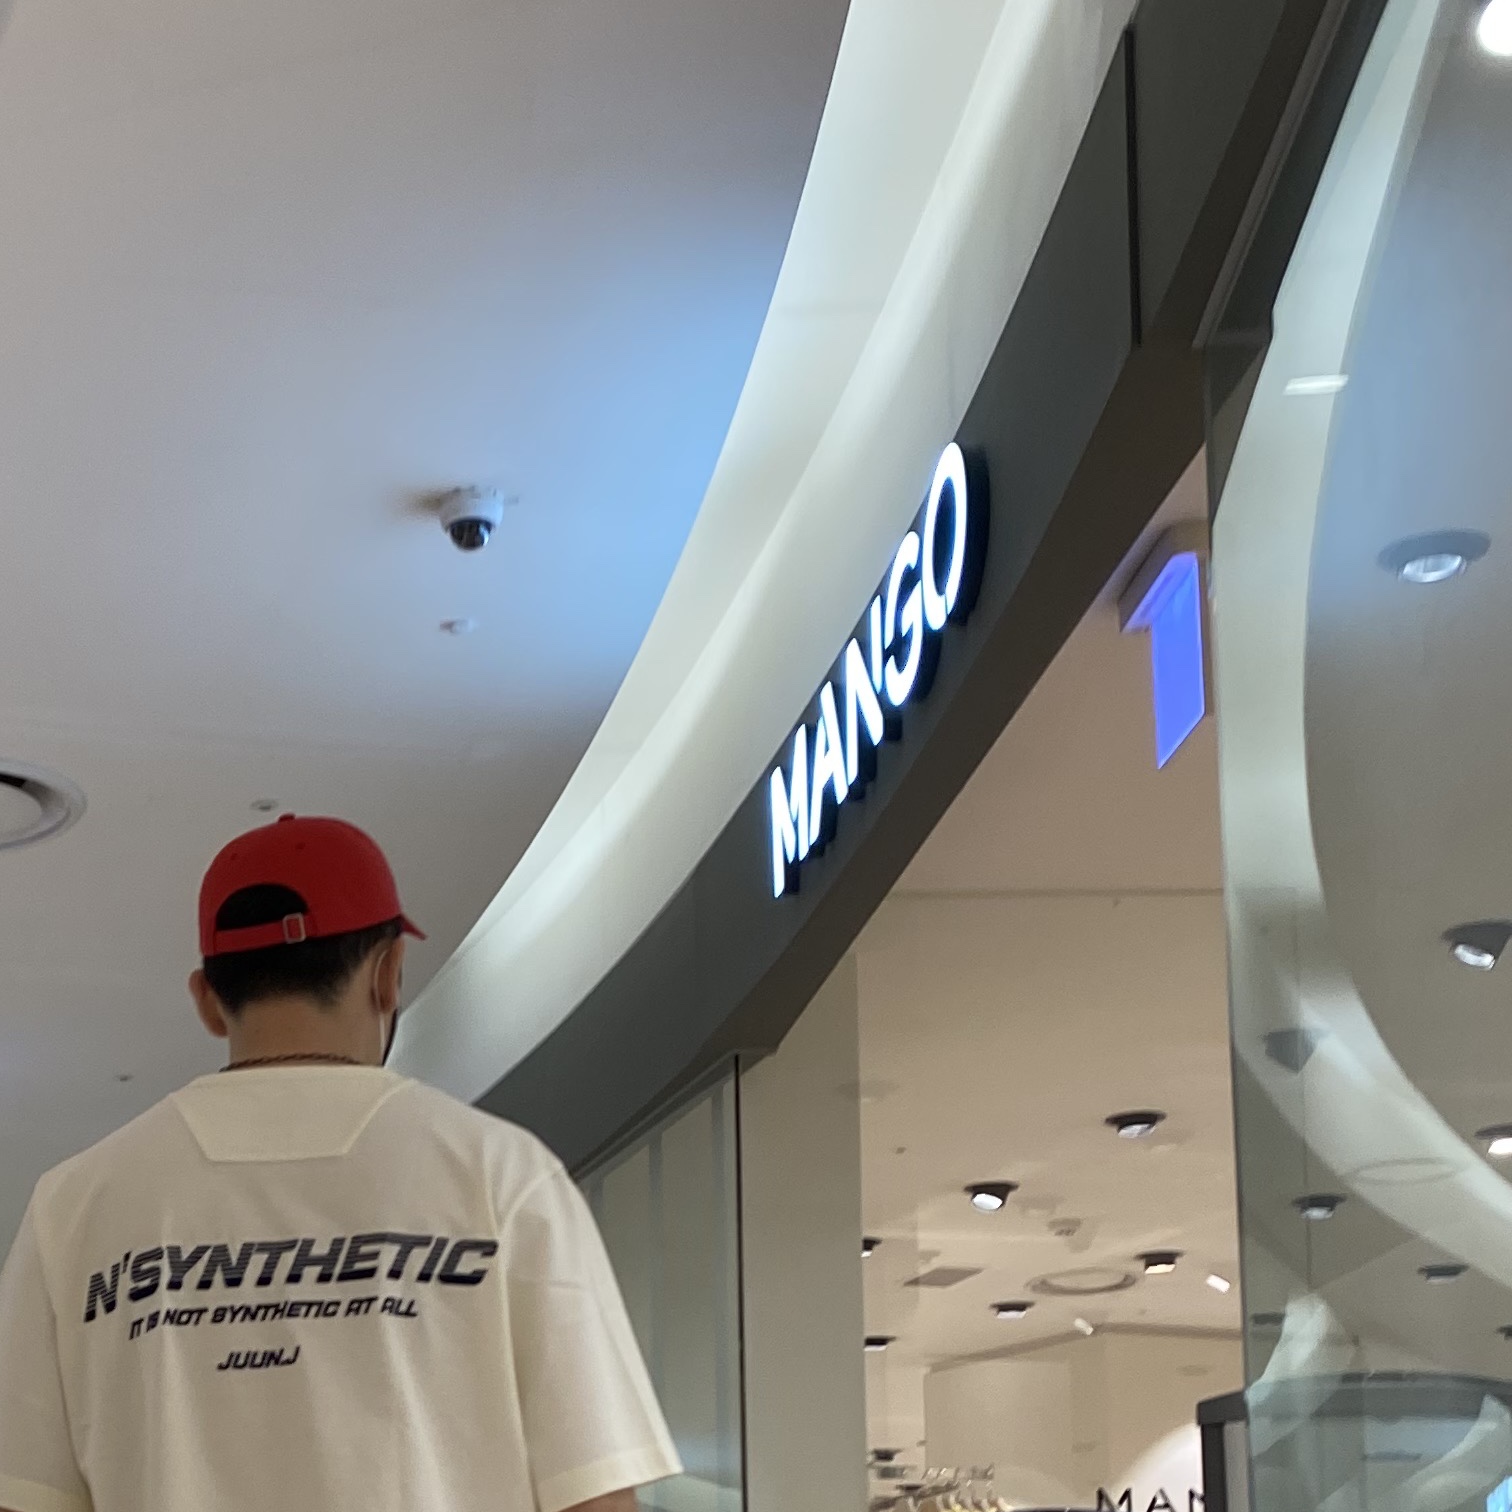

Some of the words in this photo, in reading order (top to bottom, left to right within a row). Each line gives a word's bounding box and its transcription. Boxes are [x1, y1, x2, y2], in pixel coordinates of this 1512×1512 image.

[770, 441, 968, 898] MANGO
[84, 1231, 498, 1322] N'SYNTHETIC
[129, 1318, 144, 1340] IT
[162, 1308, 209, 1326] NOT
[211, 1301, 341, 1324] SYNTHETIC
[344, 1297, 378, 1317] AT
[381, 1297, 418, 1317] ALL
